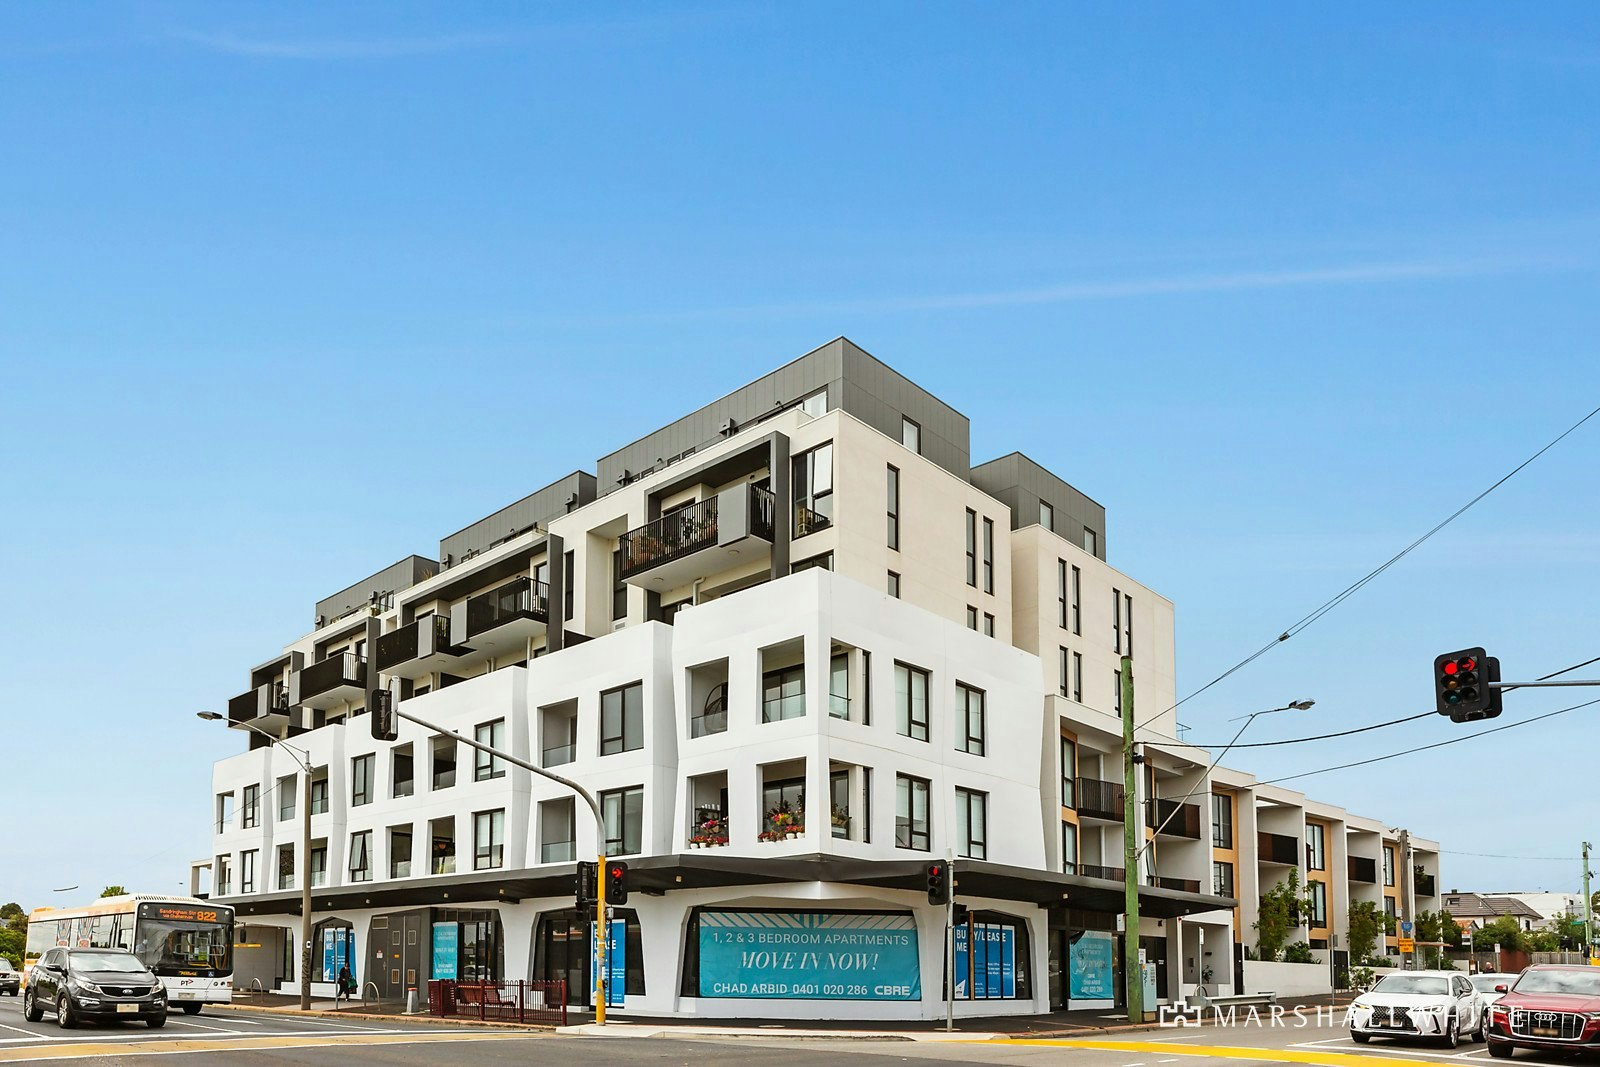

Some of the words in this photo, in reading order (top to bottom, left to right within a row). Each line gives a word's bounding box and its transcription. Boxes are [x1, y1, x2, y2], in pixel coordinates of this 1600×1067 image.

[197, 911, 217, 922] 822
[713, 932, 723, 944] 1,
[726, 932, 733, 943] 2
[736, 933, 744, 943] &
[748, 933, 755, 943] 3
[758, 933, 820, 944] BEDROOM
[824, 934, 909, 945] APARTMENTS
[738, 951, 797, 970] MOVE
[799, 952, 821, 970] IN
[824, 952, 879, 971] NOW!
[713, 982, 748, 993] CHAD
[750, 983, 788, 994] ARBID
[792, 984, 819, 994] 0401
[823, 984, 844, 995] 020
[847, 985, 868, 995] 286
[874, 985, 911, 996] CBRE
